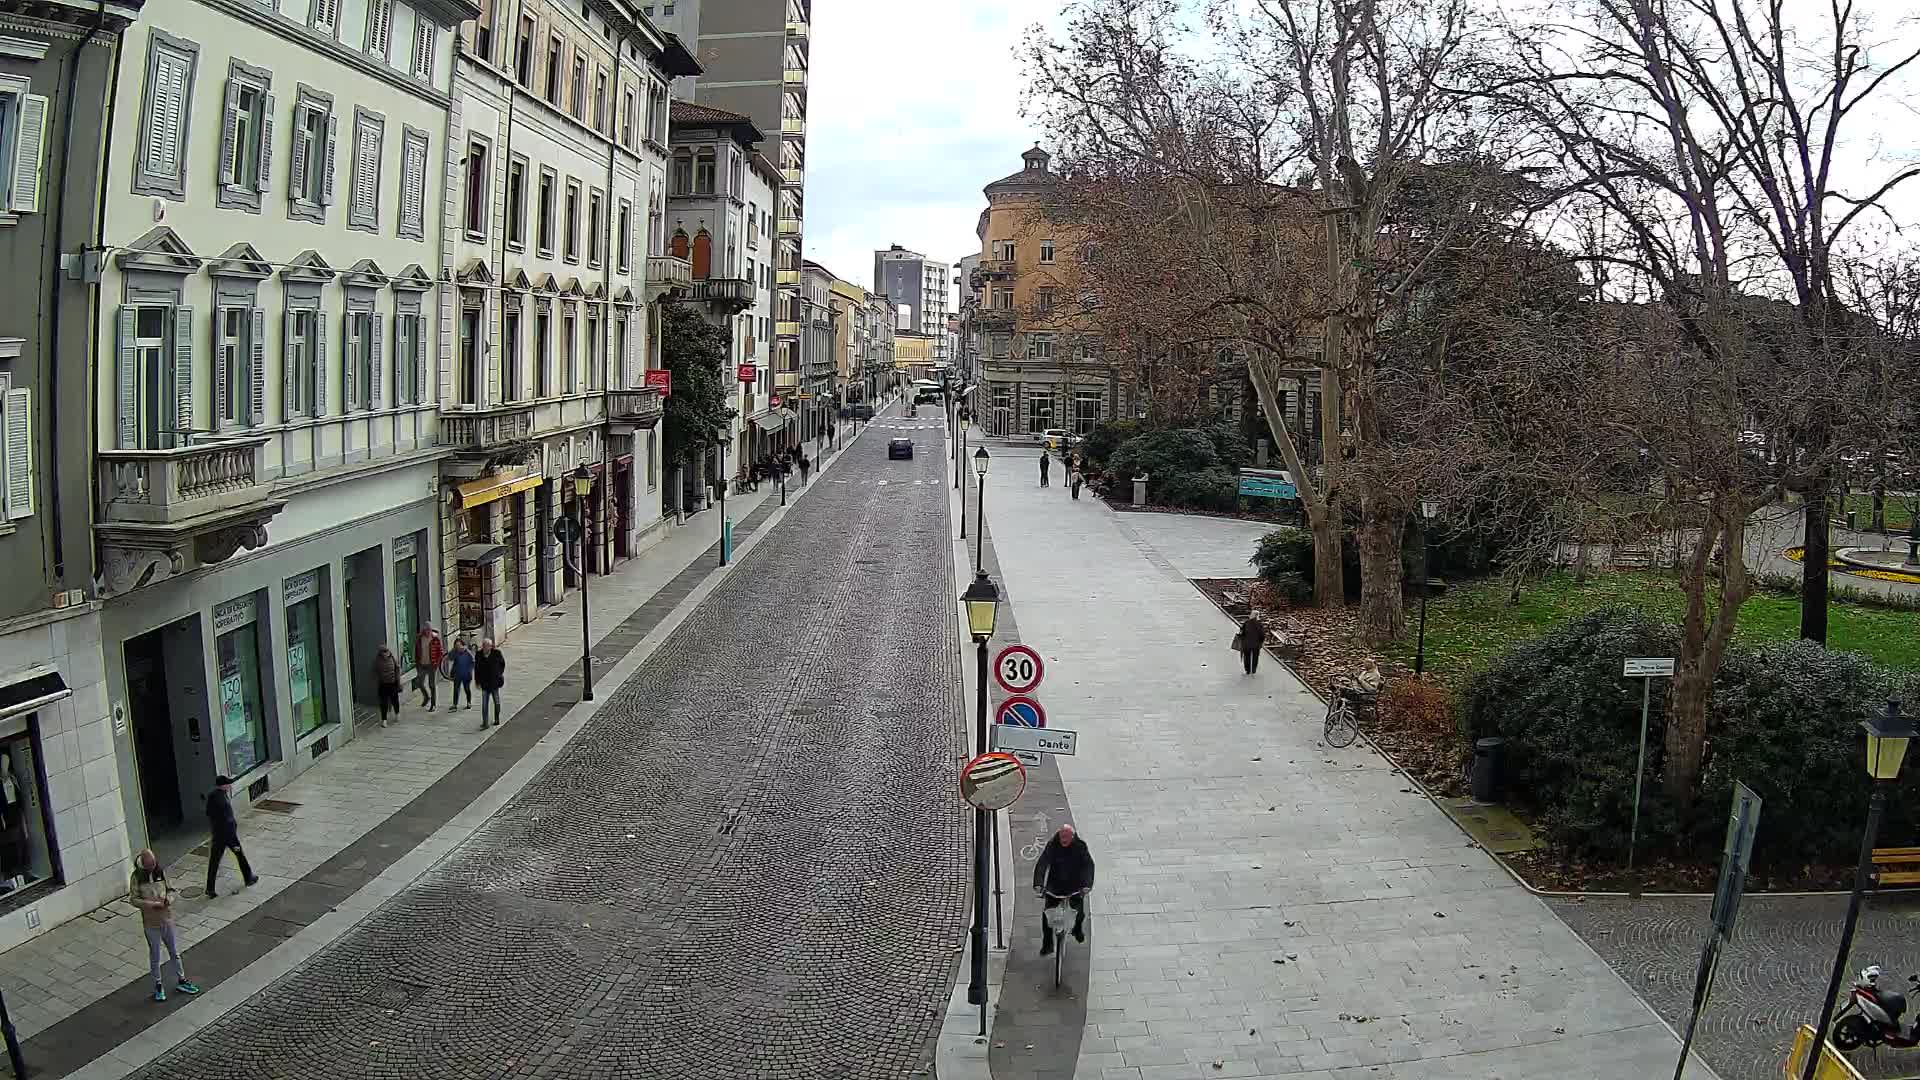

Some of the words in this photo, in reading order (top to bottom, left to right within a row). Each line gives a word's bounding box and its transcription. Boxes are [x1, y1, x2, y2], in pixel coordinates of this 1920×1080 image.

[1005, 658, 1033, 681] 30
[222, 677, 241, 701] 130
[1038, 739, 1070, 750] Dante
